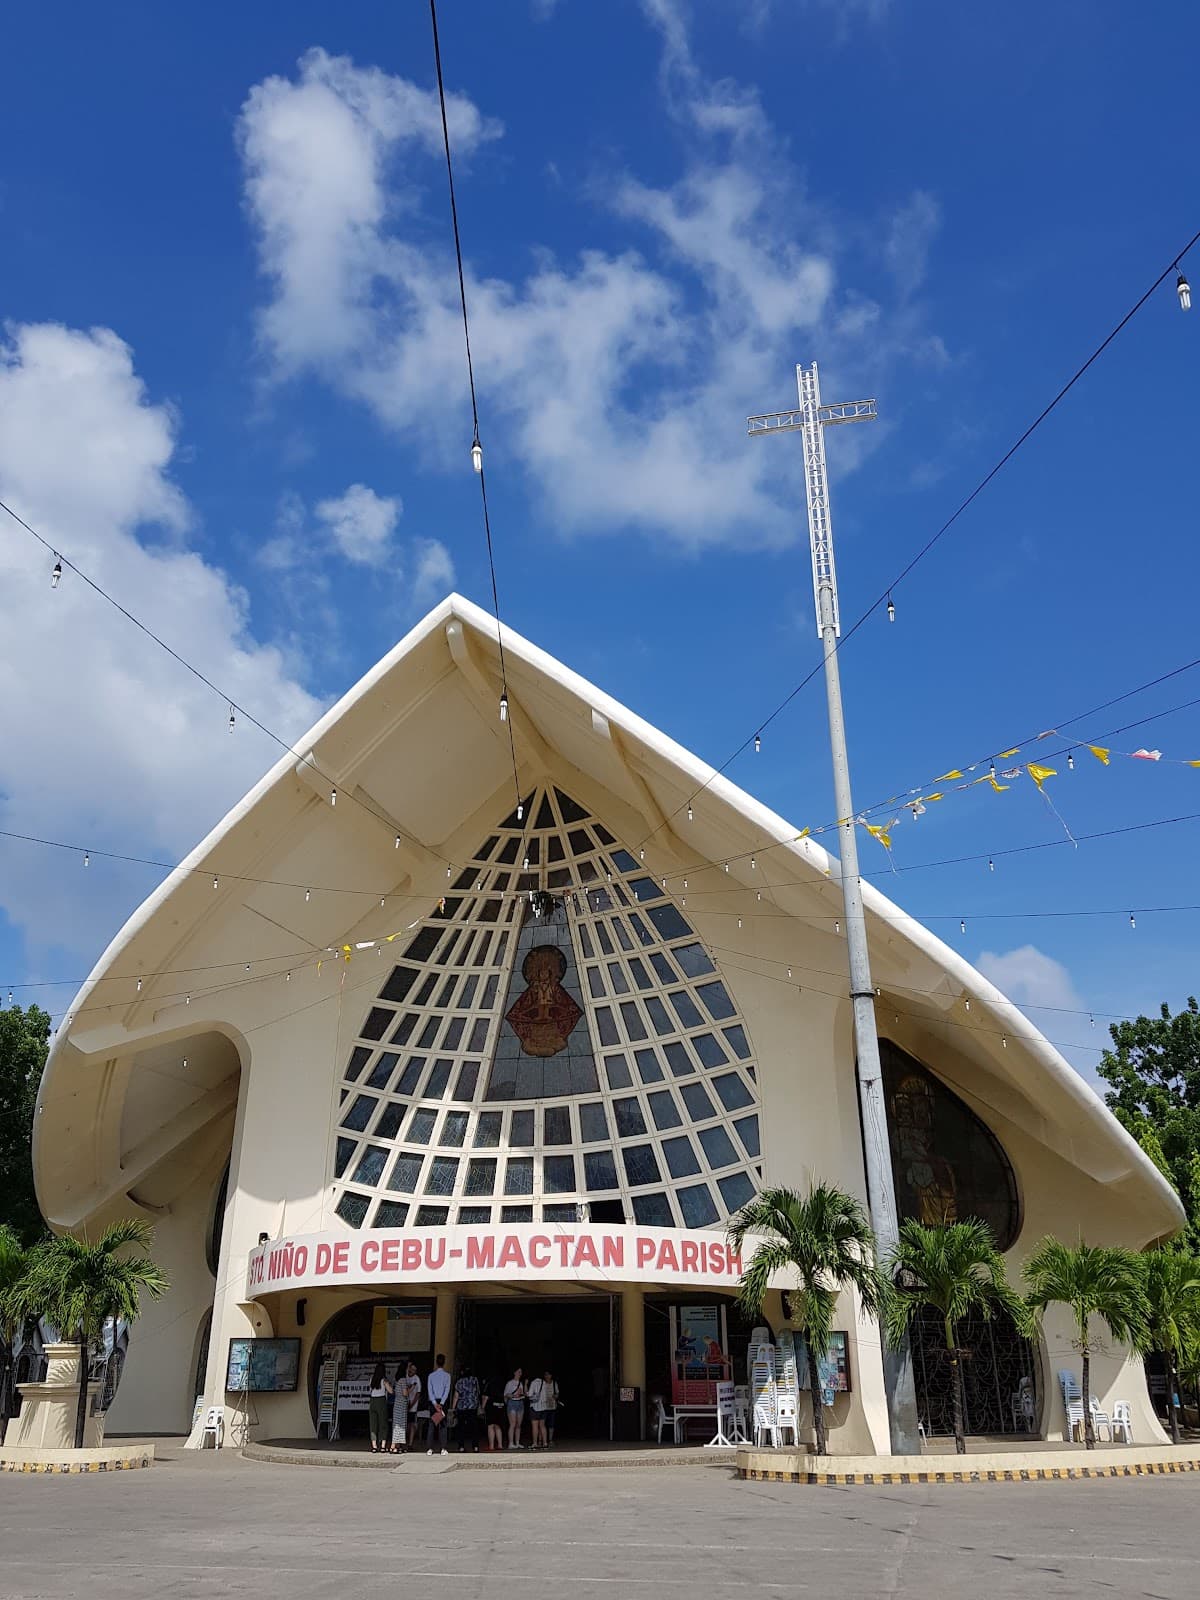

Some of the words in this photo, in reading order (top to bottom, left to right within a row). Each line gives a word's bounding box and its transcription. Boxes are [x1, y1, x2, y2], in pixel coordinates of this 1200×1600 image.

[249, 1255, 265, 1286] STO.
[268, 1241, 309, 1281] NIÑO
[315, 1241, 350, 1275] DE
[360, 1235, 625, 1273] CEBU-MACTAN
[636, 1237, 743, 1275] PARISH
